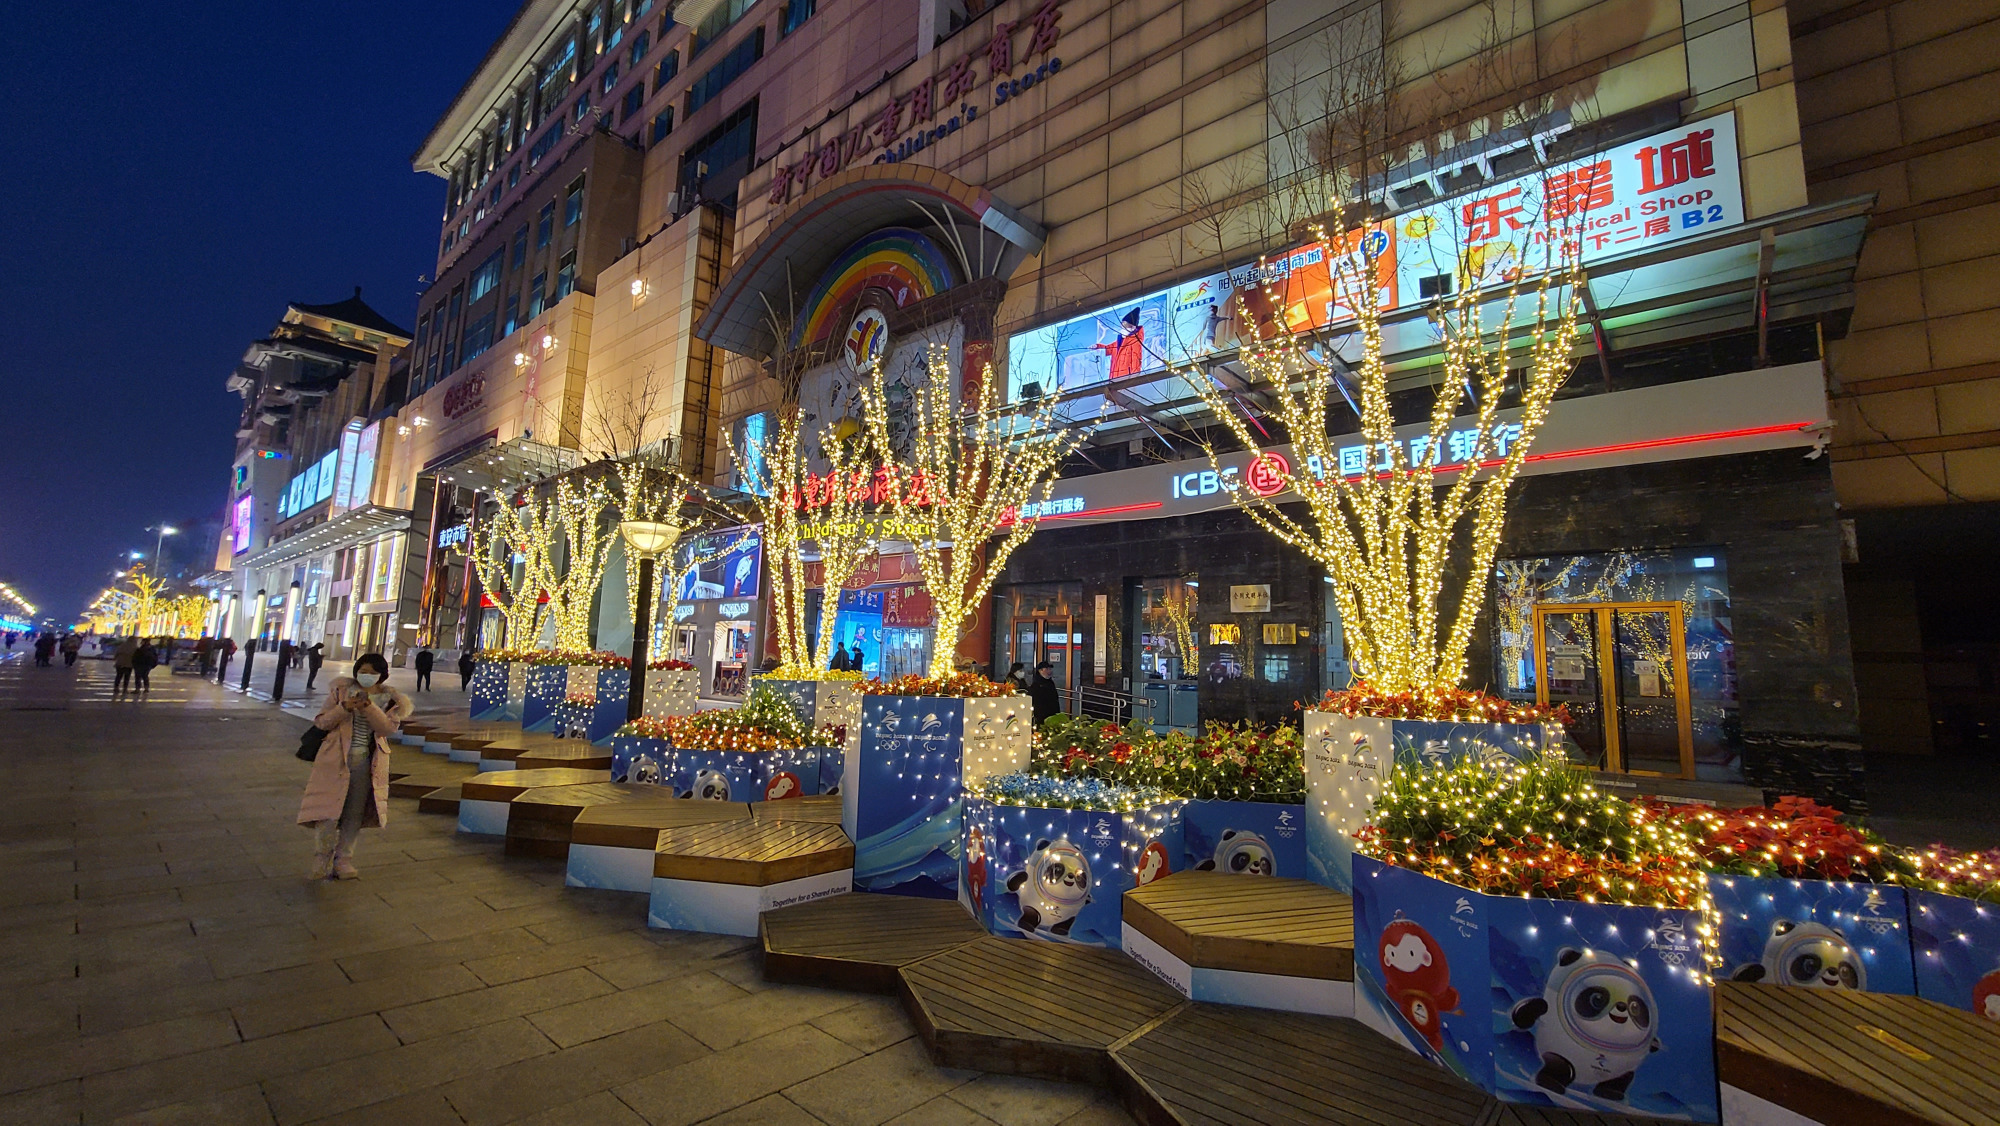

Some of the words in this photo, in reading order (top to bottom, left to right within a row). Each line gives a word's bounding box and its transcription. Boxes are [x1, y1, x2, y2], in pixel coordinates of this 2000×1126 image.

[768, 0, 1063, 205] 新中国儿童用品商店
[872, 102, 978, 165] Children's
[994, 57, 1063, 106] Store
[1461, 127, 1715, 244] 乐器城
[1535, 206, 1631, 246] Musical
[1640, 188, 1713, 217] Shop
[1558, 215, 1671, 259] 地下二层
[1681, 204, 1724, 230] B2
[1173, 467, 1239, 499] ICBC
[1315, 754, 1329, 762] BEIJING
[1347, 760, 1363, 768] BEIJING
[771, 897, 797, 909] Together
[811, 888, 830, 899] Shared
[830, 886, 847, 895] Future
[1129, 946, 1147, 964] Together
[1156, 966, 1173, 984] Shared
[1172, 978, 1188, 996] Future
